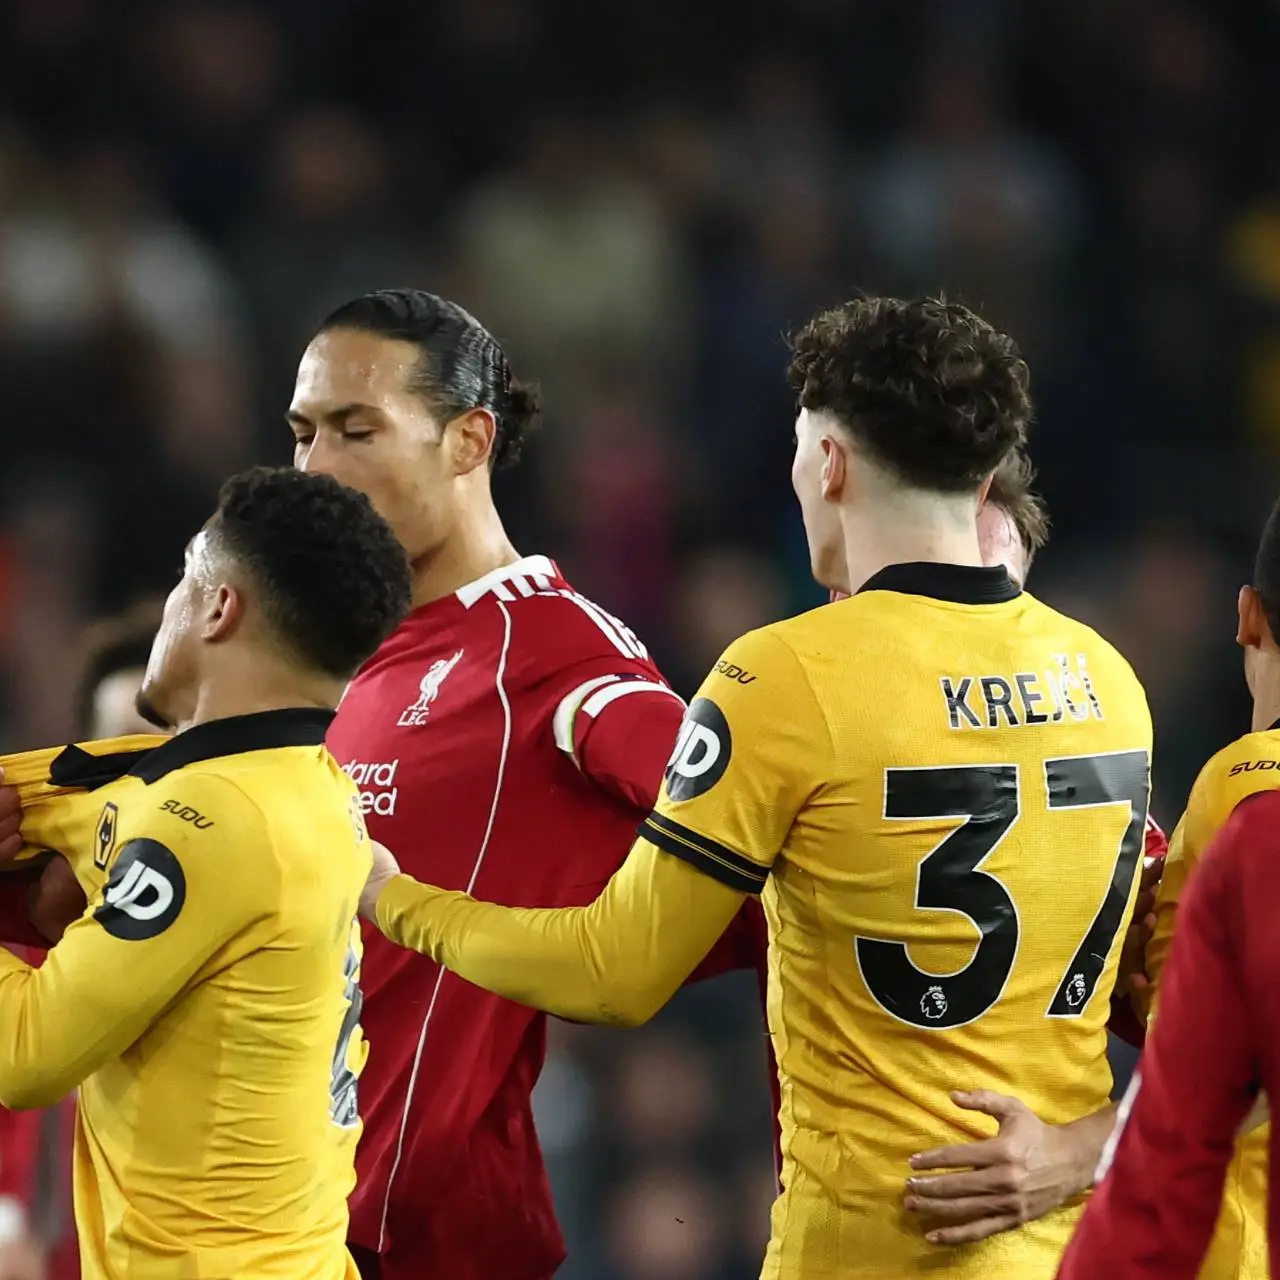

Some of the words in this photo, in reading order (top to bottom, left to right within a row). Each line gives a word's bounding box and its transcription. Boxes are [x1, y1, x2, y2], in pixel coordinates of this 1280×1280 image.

[159, 799, 215, 830] SUDU
[106, 859, 174, 921] JD
[854, 749, 1151, 1031] 37
